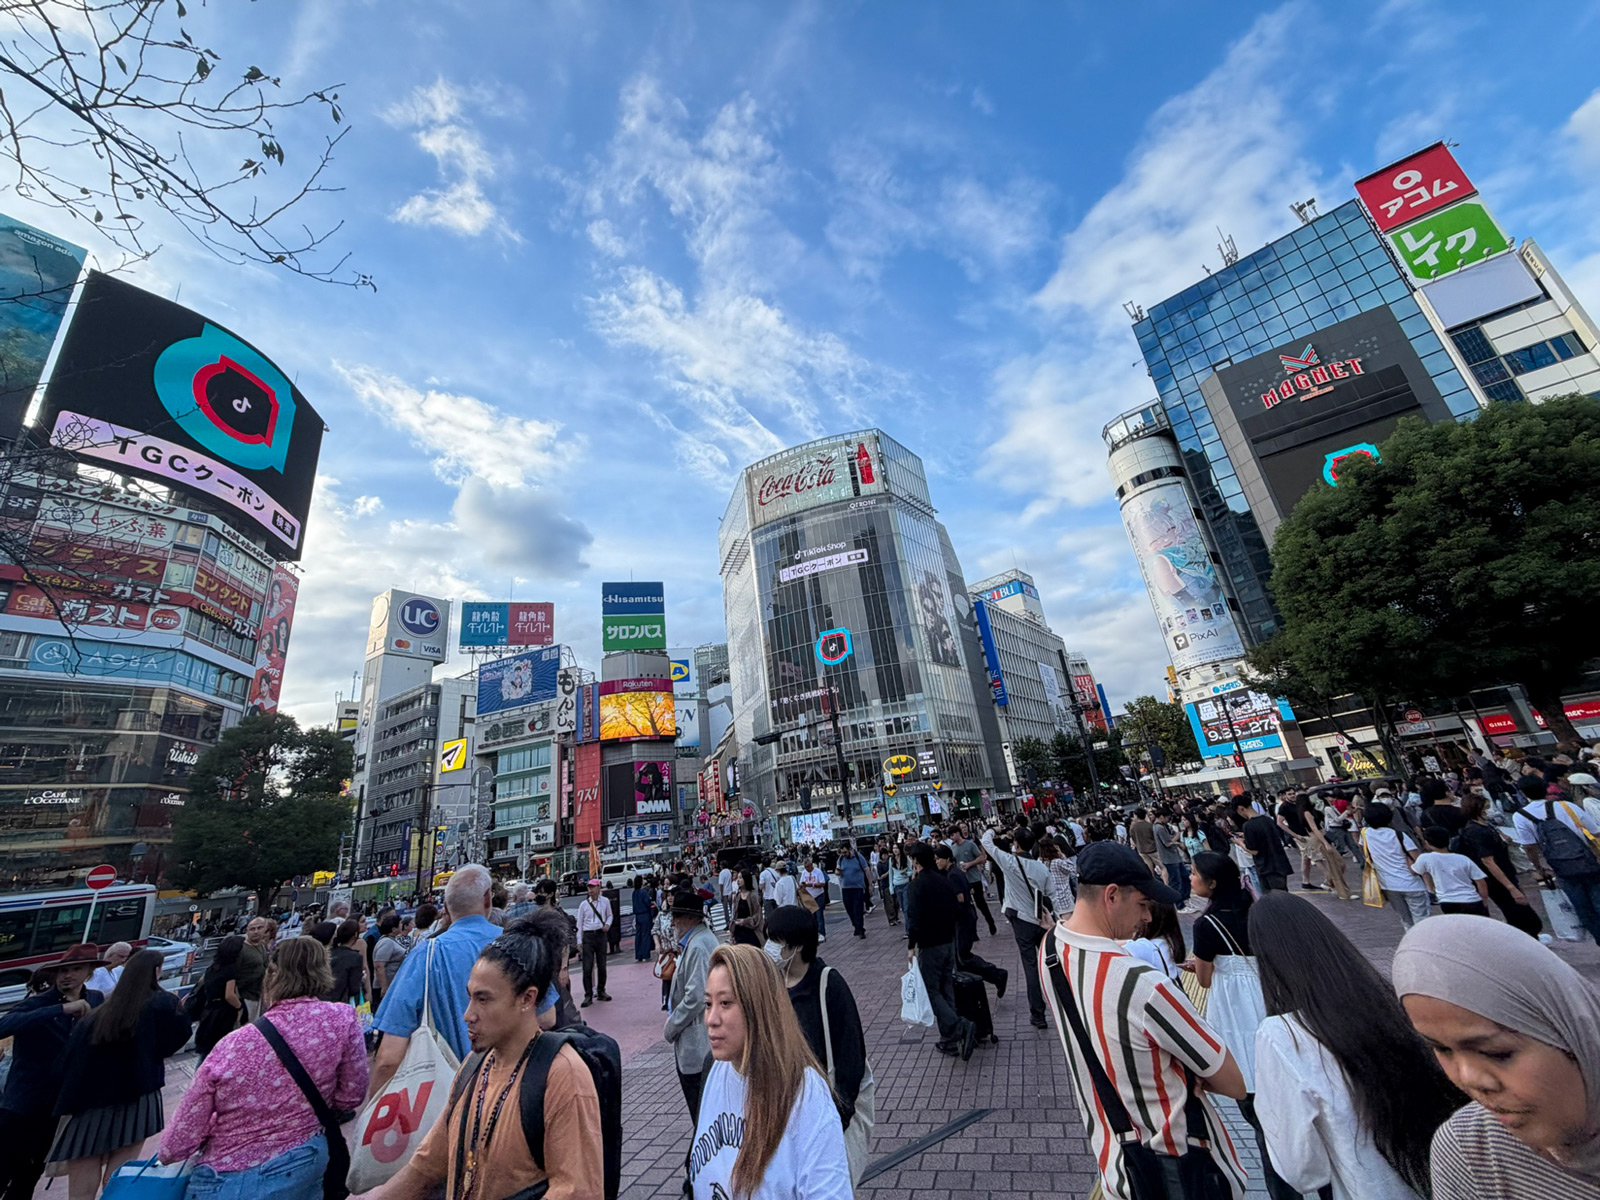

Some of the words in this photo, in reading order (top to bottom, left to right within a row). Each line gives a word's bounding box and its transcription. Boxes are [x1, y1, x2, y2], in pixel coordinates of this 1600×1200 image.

[1379, 178, 1459, 219] アコム
[14, 229, 54, 250] amazon
[55, 244, 73, 257] ads
[1400, 226, 1477, 267] レイク
[1261, 358, 1365, 410] MAGNET
[113, 434, 267, 512] TGCクーポン
[758, 453, 838, 506] Coca-Cola
[802, 546, 826, 557] TikTok
[826, 541, 847, 551] Shop
[790, 557, 842, 576] TGCクーポン
[110, 581, 171, 604] ガスト
[195, 571, 250, 613] コンタクト
[603, 594, 664, 603] Hisamitsu
[61, 599, 141, 627] ガスト
[154, 616, 178, 625] ガスト
[232, 618, 257, 638] ガスト
[606, 624, 663, 640] サロンパス
[1189, 628, 1220, 643] PixAI
[423, 645, 441, 654] VISA
[87, 651, 158, 669] AOBA
[175, 661, 216, 685] CLINC
[558, 670, 577, 731] もんじゃ
[170, 748, 198, 765] Ushi8
[928, 766, 938, 775] B1
[796, 781, 867, 800] SARBUKS
[901, 785, 929, 793] TSUTAYA
[637, 800, 671, 814] DMM
